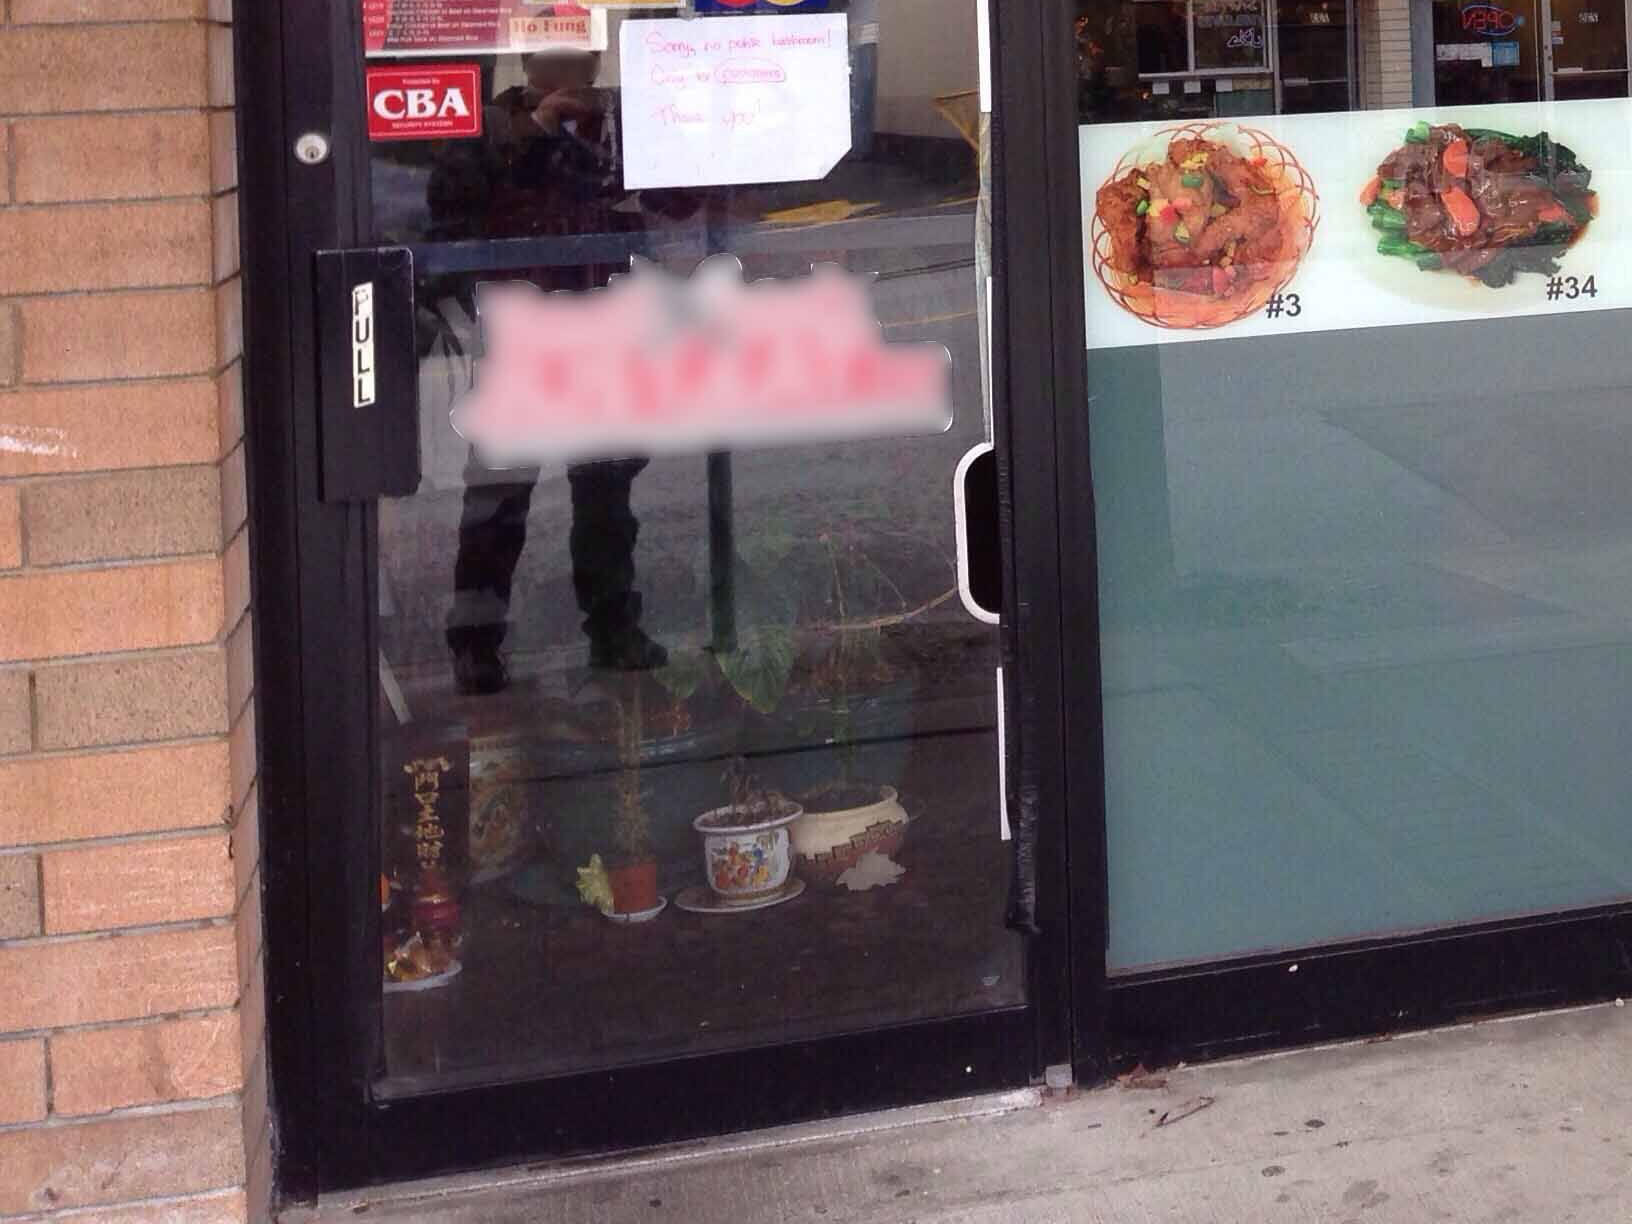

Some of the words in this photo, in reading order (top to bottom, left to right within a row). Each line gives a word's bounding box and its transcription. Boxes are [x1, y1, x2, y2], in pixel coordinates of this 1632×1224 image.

[373, 88, 470, 120] CBA
[1546, 275, 1599, 300] #34
[1265, 293, 1302, 319] #3
[352, 284, 376, 408] PULL
